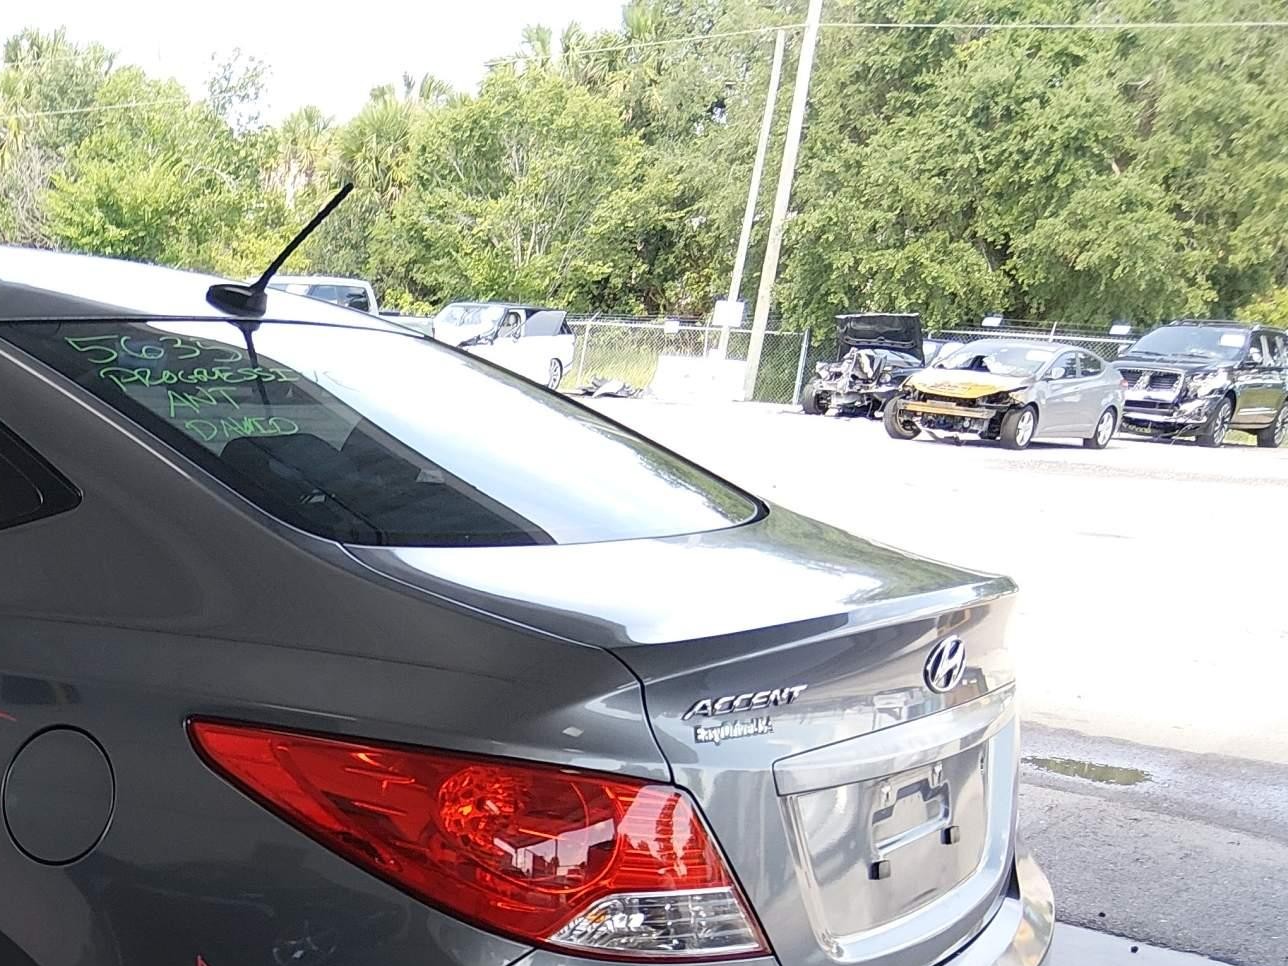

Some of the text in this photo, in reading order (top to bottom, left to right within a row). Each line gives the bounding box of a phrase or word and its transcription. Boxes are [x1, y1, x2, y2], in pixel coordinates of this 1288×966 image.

[64, 334, 243, 364] 5635
[184, 416, 299, 441] DAVID
[681, 684, 809, 721] ACCENT
